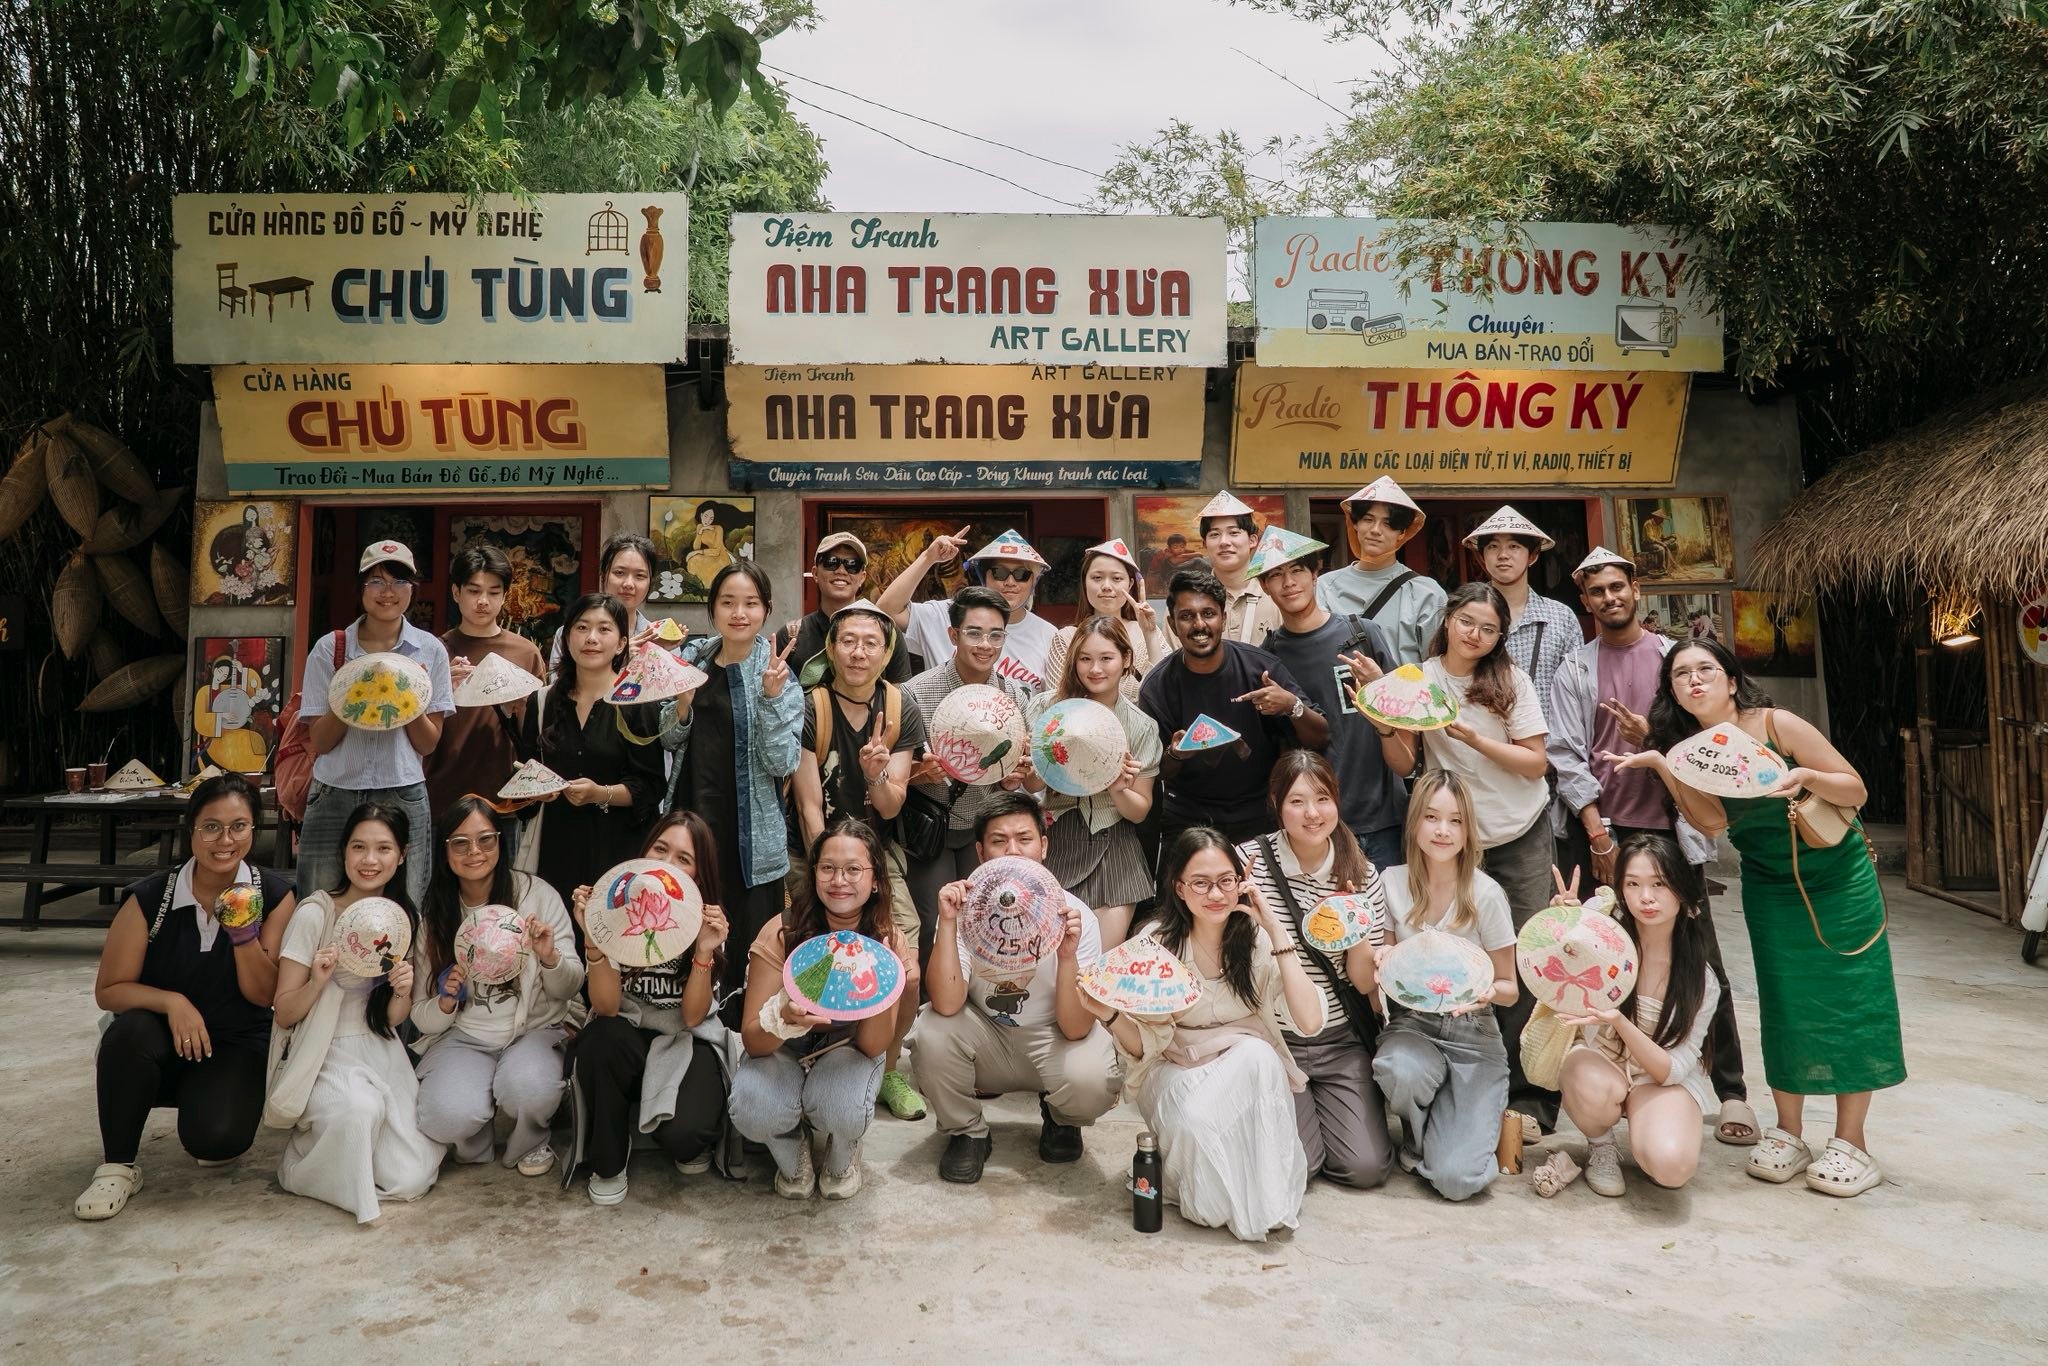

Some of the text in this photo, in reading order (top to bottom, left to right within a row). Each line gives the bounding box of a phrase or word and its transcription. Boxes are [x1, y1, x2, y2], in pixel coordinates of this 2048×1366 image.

[208, 202, 256, 236] CỬA
[263, 202, 326, 236] HÀNG
[333, 201, 367, 235] ĐỒ
[372, 200, 407, 236] GỖ
[429, 203, 468, 237] MỸ
[763, 217, 940, 253] Tiệm Tranh
[1274, 231, 1391, 289] Radio
[1620, 238, 1688, 299] KÝ
[471, 256, 631, 322] TÙNG
[766, 263, 1191, 318] NHA TRANG XƯA
[989, 325, 1191, 353] ART GALLERY
[1427, 341, 1468, 361] MUA
[243, 368, 352, 392] CỬA HÀNG
[764, 367, 856, 384] Tiệm Tranh
[1031, 365, 1178, 382] ART GALLERY
[1244, 371, 1644, 431] Radio THÔNG KÝ
[765, 390, 1150, 441] NHA TRANG XƯA
[1298, 451, 1332, 470] MUA
[1339, 448, 1369, 470] BÁN
[1373, 449, 1400, 470] CÁC
[273, 466, 317, 485] Trao
[362, 468, 395, 484] Mua
[401, 466, 432, 483] Bán
[439, 465, 462, 484] Đồ
[528, 465, 556, 486] Mỹ
[814, 467, 851, 482] Tranh
[915, 467, 937, 482] Cao
[1013, 465, 1054, 486] Khung
[1096, 465, 1119, 481] các
[996, 655, 1043, 690] Nam
[1686, 752, 1739, 776] Camp 2025
[1698, 746, 1721, 759] CCT
[989, 913, 1025, 936] CCT
[346, 931, 373, 960] CCT
[996, 937, 1021, 956] 25
[1115, 976, 1149, 996] Nha
